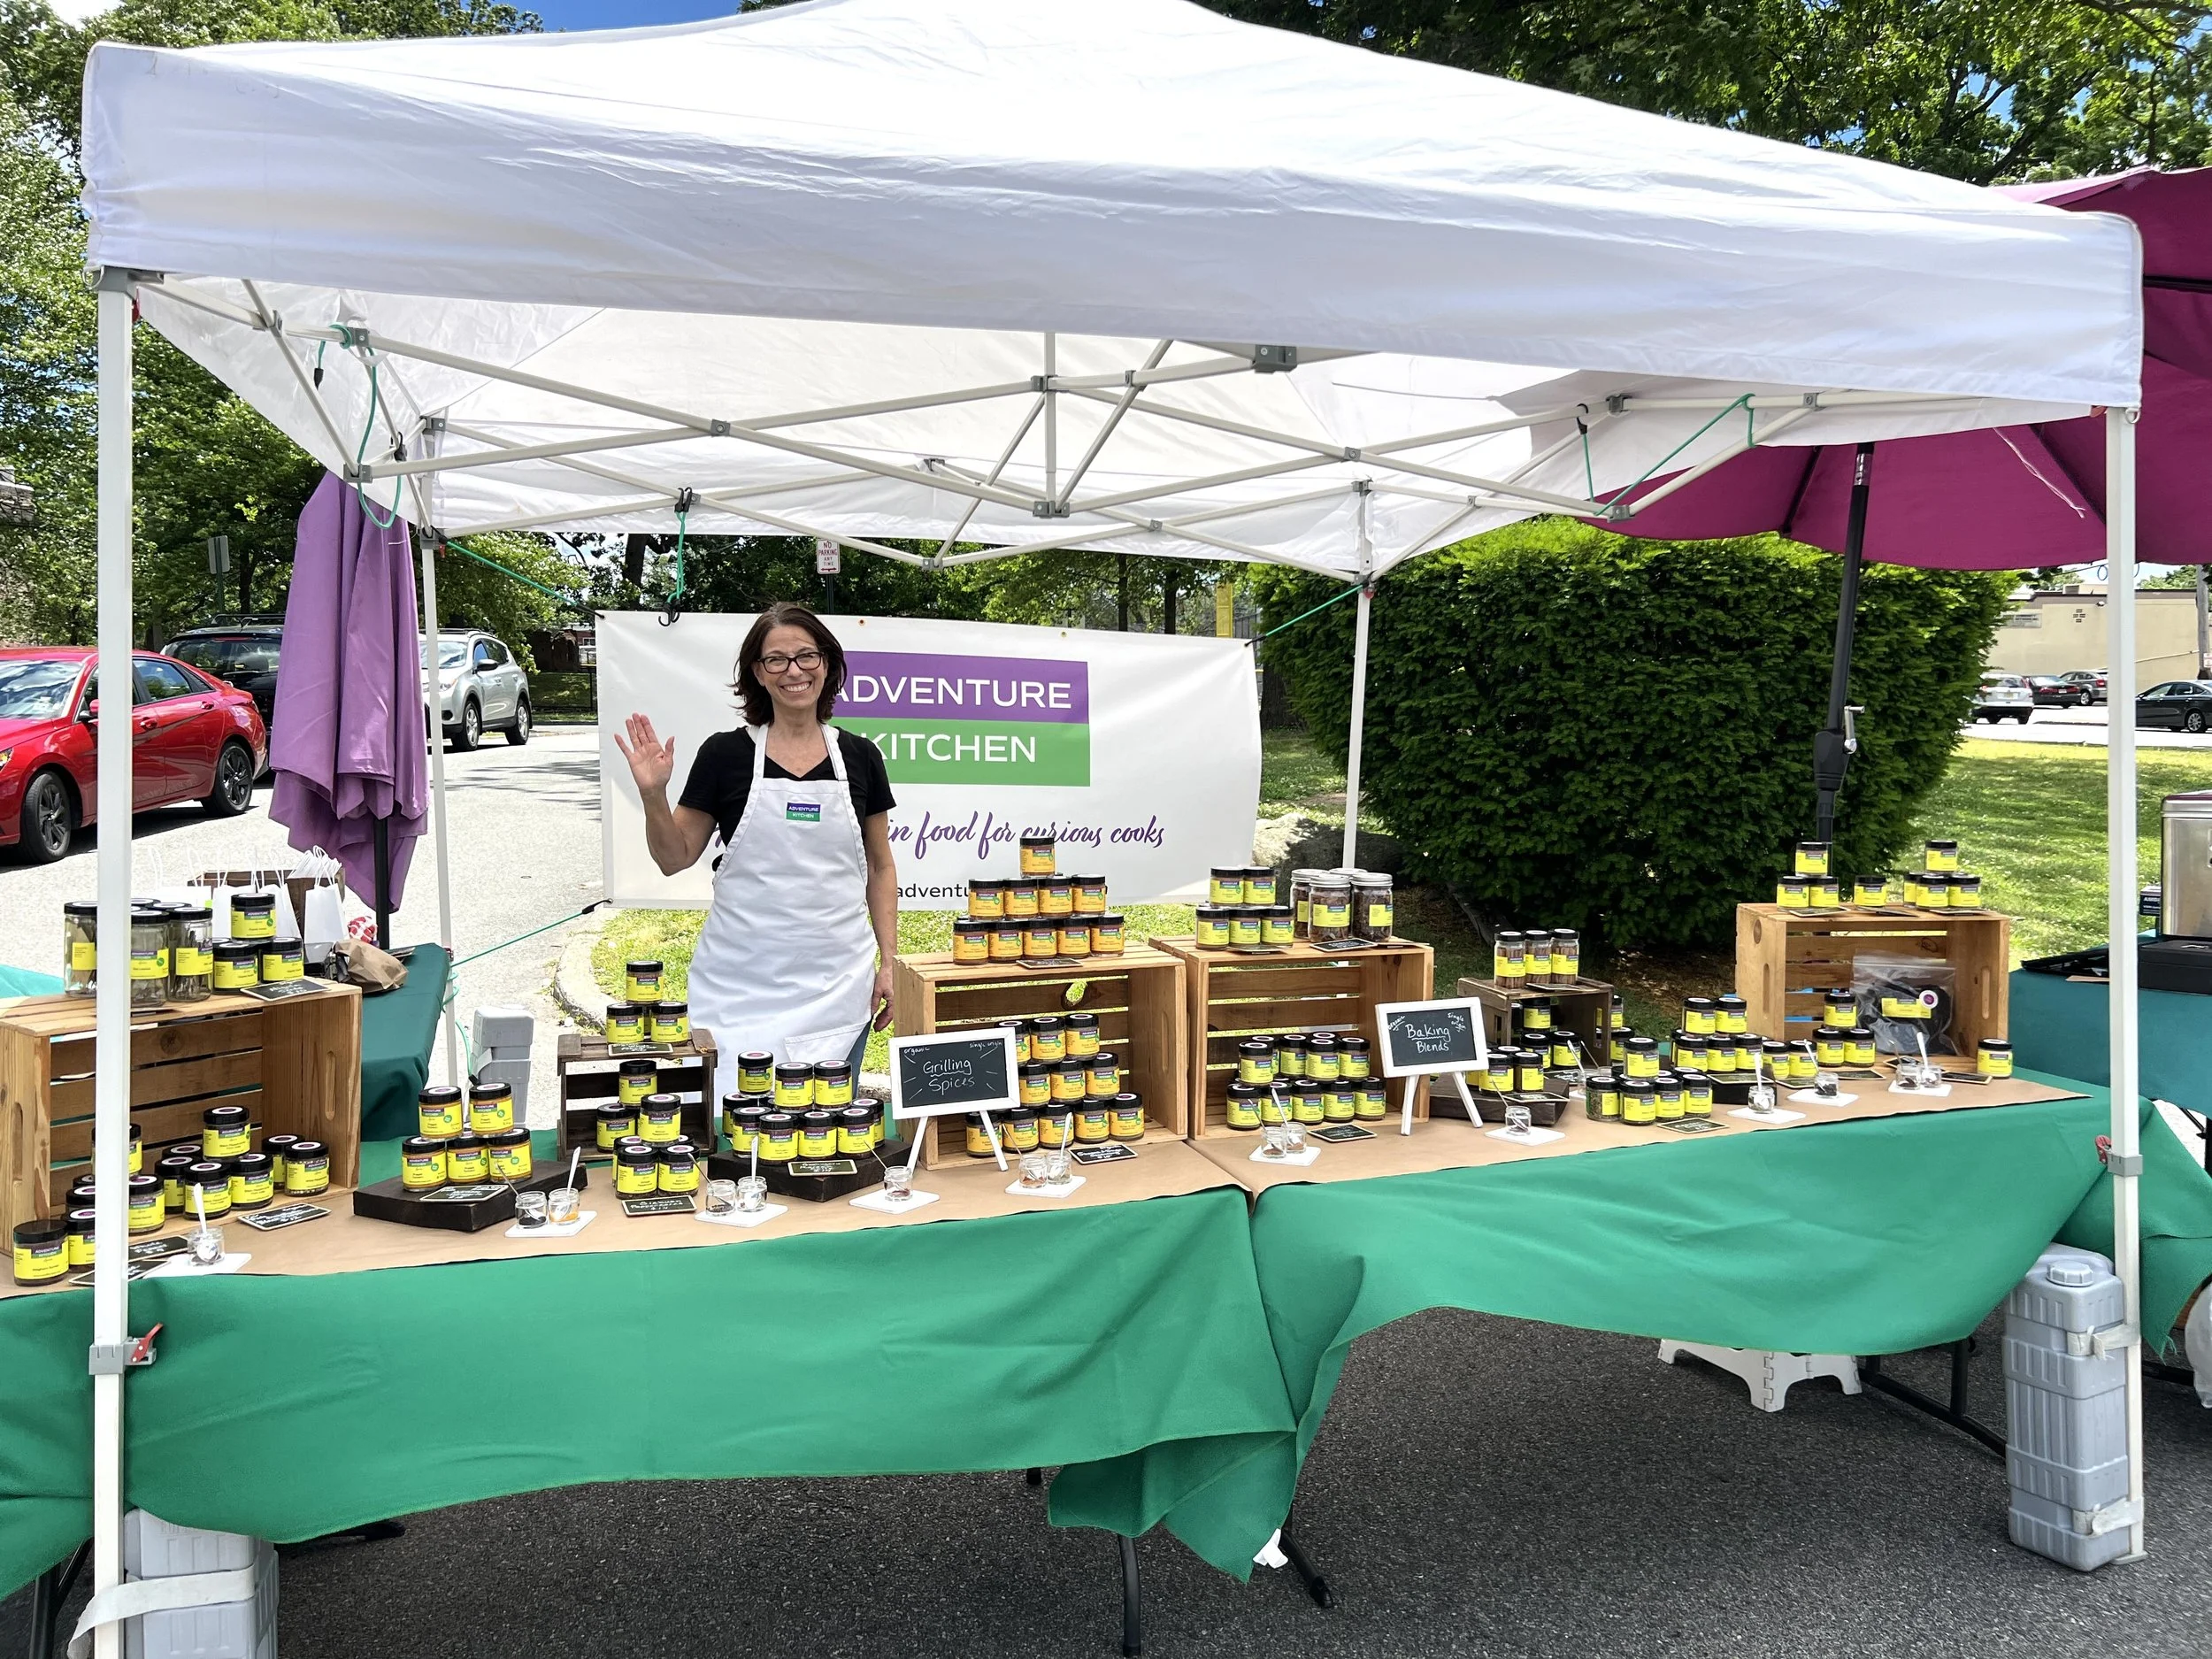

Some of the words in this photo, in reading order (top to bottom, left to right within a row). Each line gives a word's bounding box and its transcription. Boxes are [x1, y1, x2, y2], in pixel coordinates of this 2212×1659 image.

[915, 810, 977, 859] food
[978, 811, 1016, 860] for
[1021, 821, 1102, 848] curious
[1110, 815, 1164, 849] cooks
[1405, 1024, 1451, 1043] Baking
[904, 1047, 930, 1056] organic
[1416, 1041, 1449, 1053] Blends
[923, 1058, 972, 1076] Grilling
[928, 1076, 975, 1095] Spices
